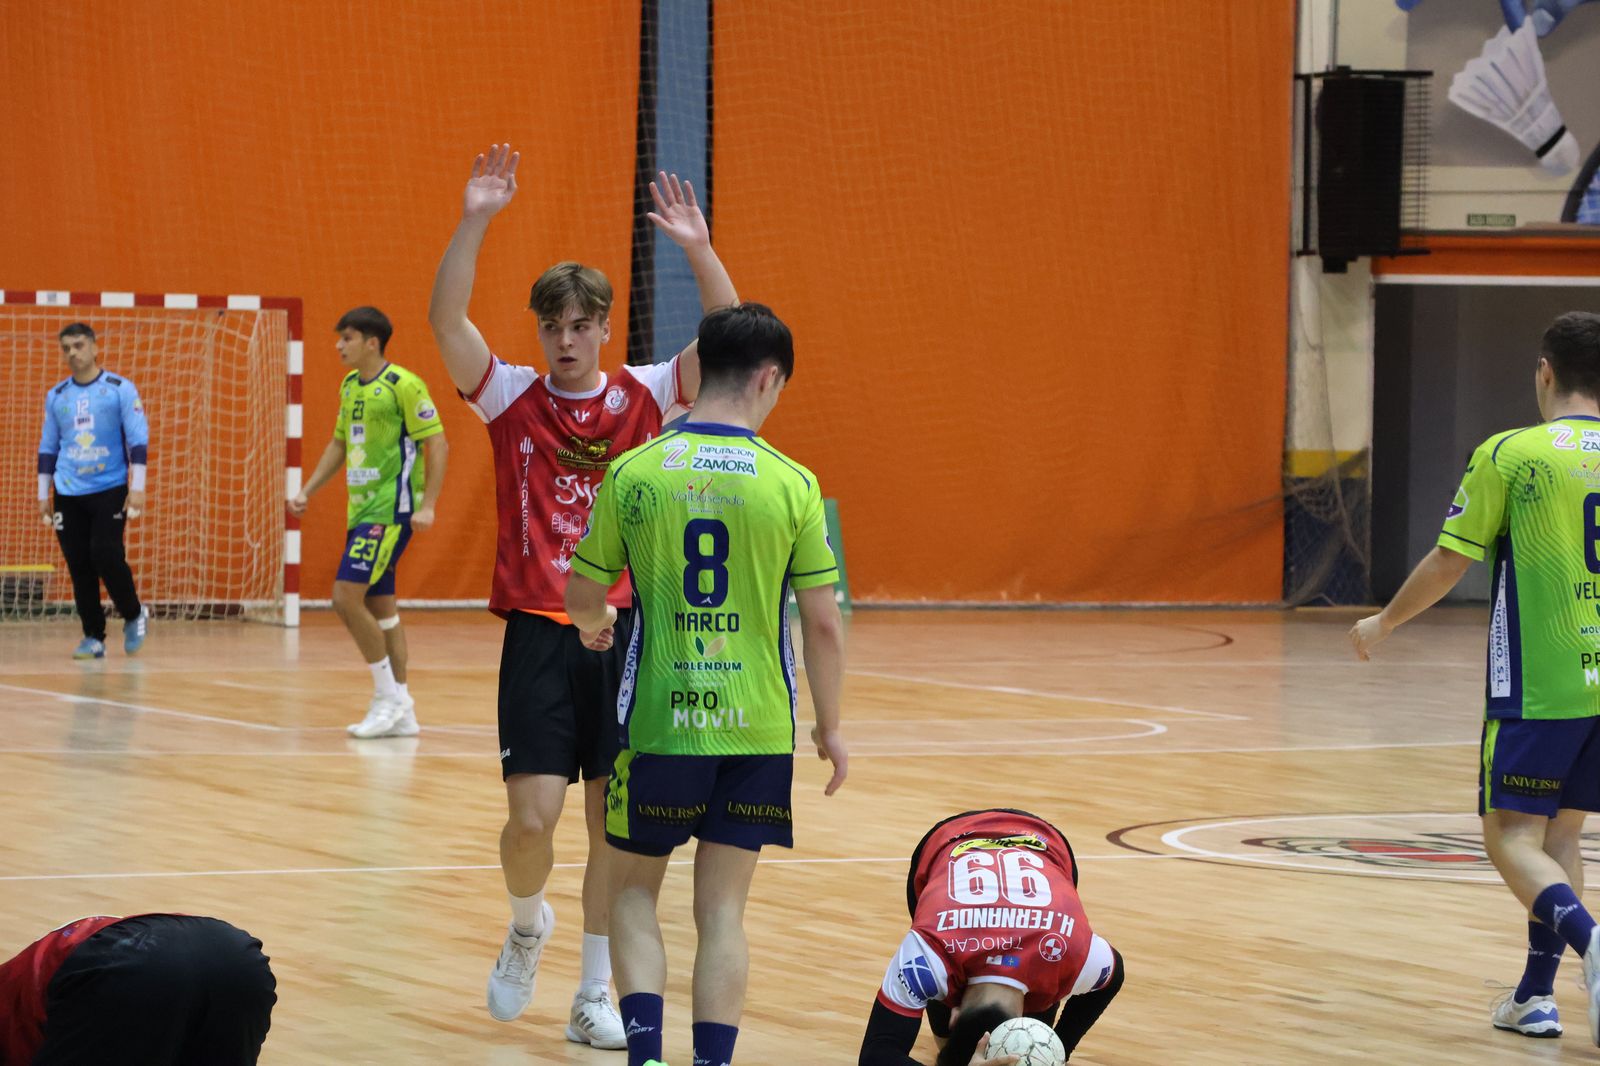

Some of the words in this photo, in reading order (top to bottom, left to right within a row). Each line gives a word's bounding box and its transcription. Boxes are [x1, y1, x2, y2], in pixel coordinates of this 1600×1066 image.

[352, 400, 365, 420] 23
[692, 457, 756, 475] ZAMORA
[348, 536, 379, 561] 23
[683, 518, 729, 608] 8
[675, 612, 740, 632] MARCO
[673, 661, 742, 671] MOLENDUM
[670, 690, 718, 710] PRO
[936, 907, 1055, 932] FERNANDEZ
[1057, 912, 1075, 938] H.
[942, 935, 1024, 954] TRIOCAR
